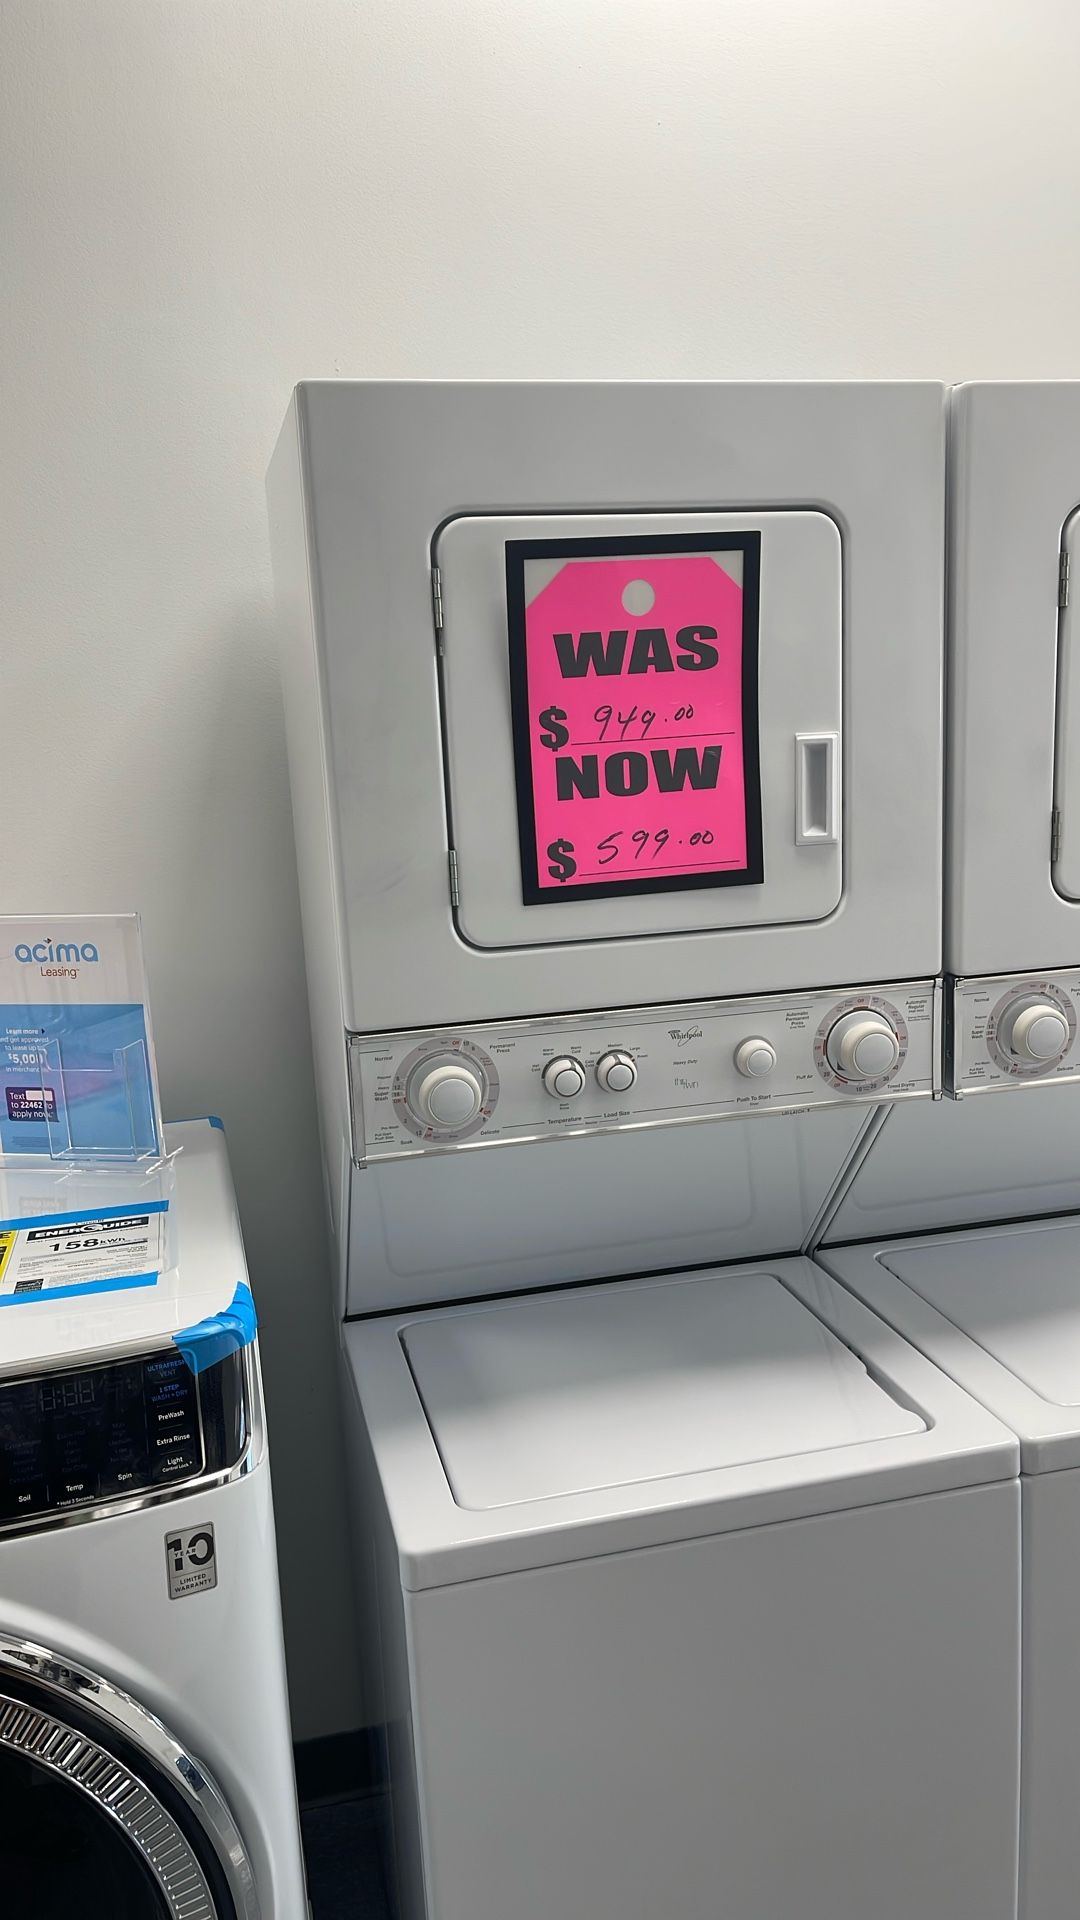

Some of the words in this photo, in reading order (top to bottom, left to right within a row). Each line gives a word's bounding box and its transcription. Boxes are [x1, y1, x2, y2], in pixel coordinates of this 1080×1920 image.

[553, 625, 719, 679] WAS
[538, 706, 570, 752] $
[593, 703, 695, 741] 949.00
[555, 745, 723, 801] NOW
[547, 838, 577, 883] $
[597, 829, 715, 865] 599.00
[15, 938, 98, 962] acima
[669, 1029, 702, 1041] Whirlpool
[12, 1110, 32, 1119] apply
[49, 1239, 99, 1251] 158
[158, 1410, 184, 1421] PreWash
[157, 1437, 172, 1446] Extra
[167, 1457, 183, 1466] Light
[117, 1472, 133, 1481] Spin
[66, 1484, 84, 1492] Temp
[18, 1494, 31, 1503] Soil
[167, 1532, 214, 1572] 10
[174, 1548, 196, 1558] YEAR
[175, 1578, 211, 1592] WARRANTY
[180, 1573, 206, 1585] LIMITED
